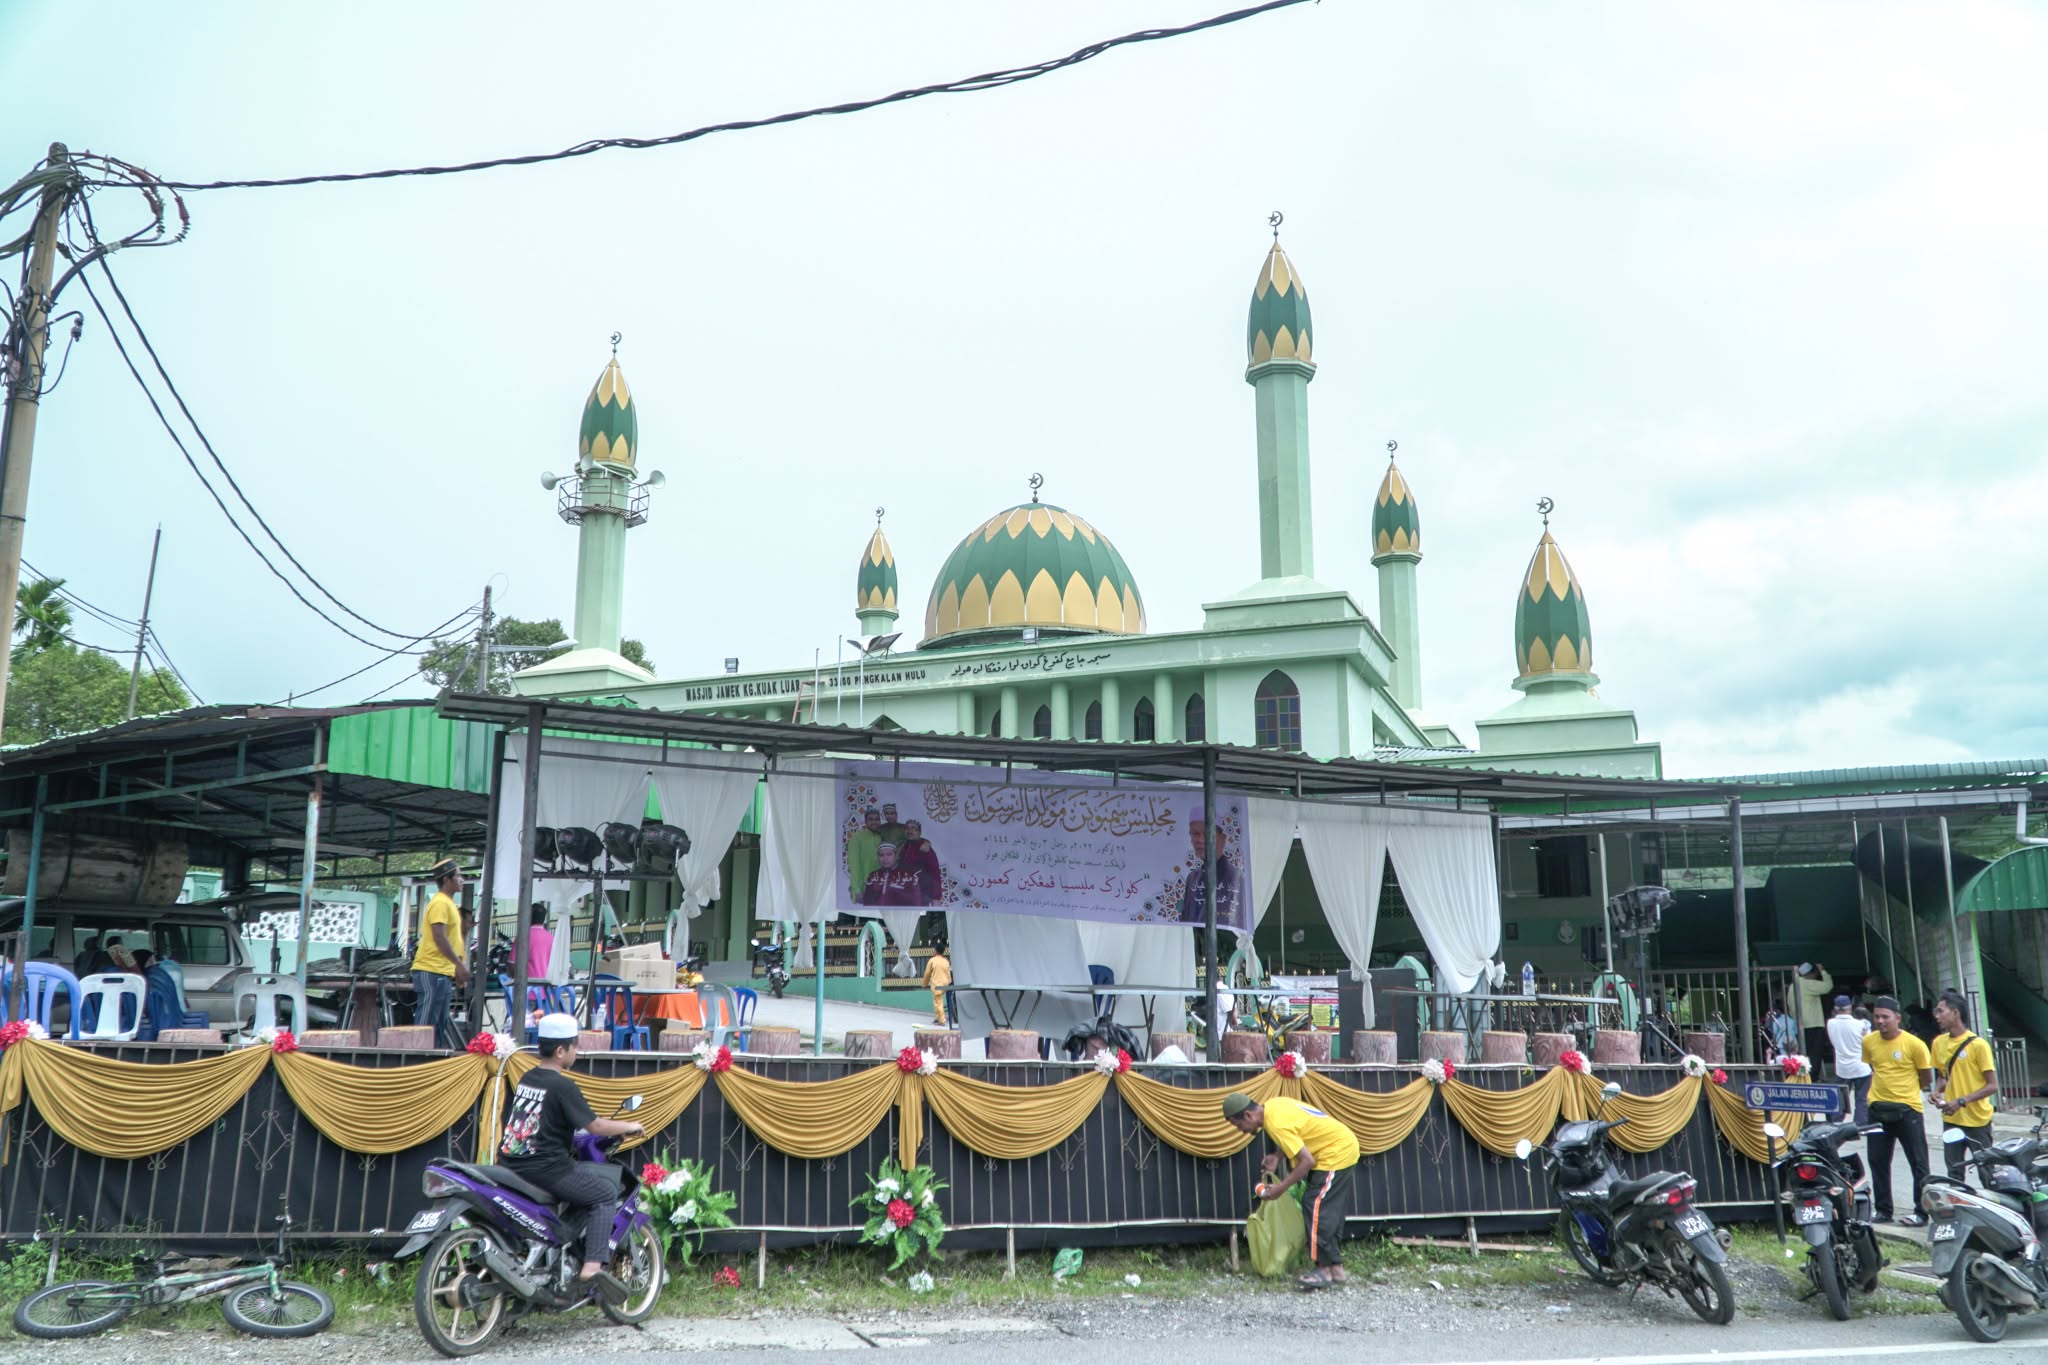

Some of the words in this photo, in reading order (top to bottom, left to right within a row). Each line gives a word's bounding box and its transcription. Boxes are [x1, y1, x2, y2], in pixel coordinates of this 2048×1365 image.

[685, 686, 713, 702] MASJID
[716, 684, 740, 699] JAMEK
[780, 679, 800, 694] LUAR
[905, 669, 926, 681] HULU
[516, 1084, 547, 1102] WHITE
[1768, 1087, 1789, 1098] JALAN
[1790, 1089, 1809, 1099] JERAI
[1810, 1090, 1828, 1100] RAJA
[1681, 1214, 1702, 1228] VBJ
